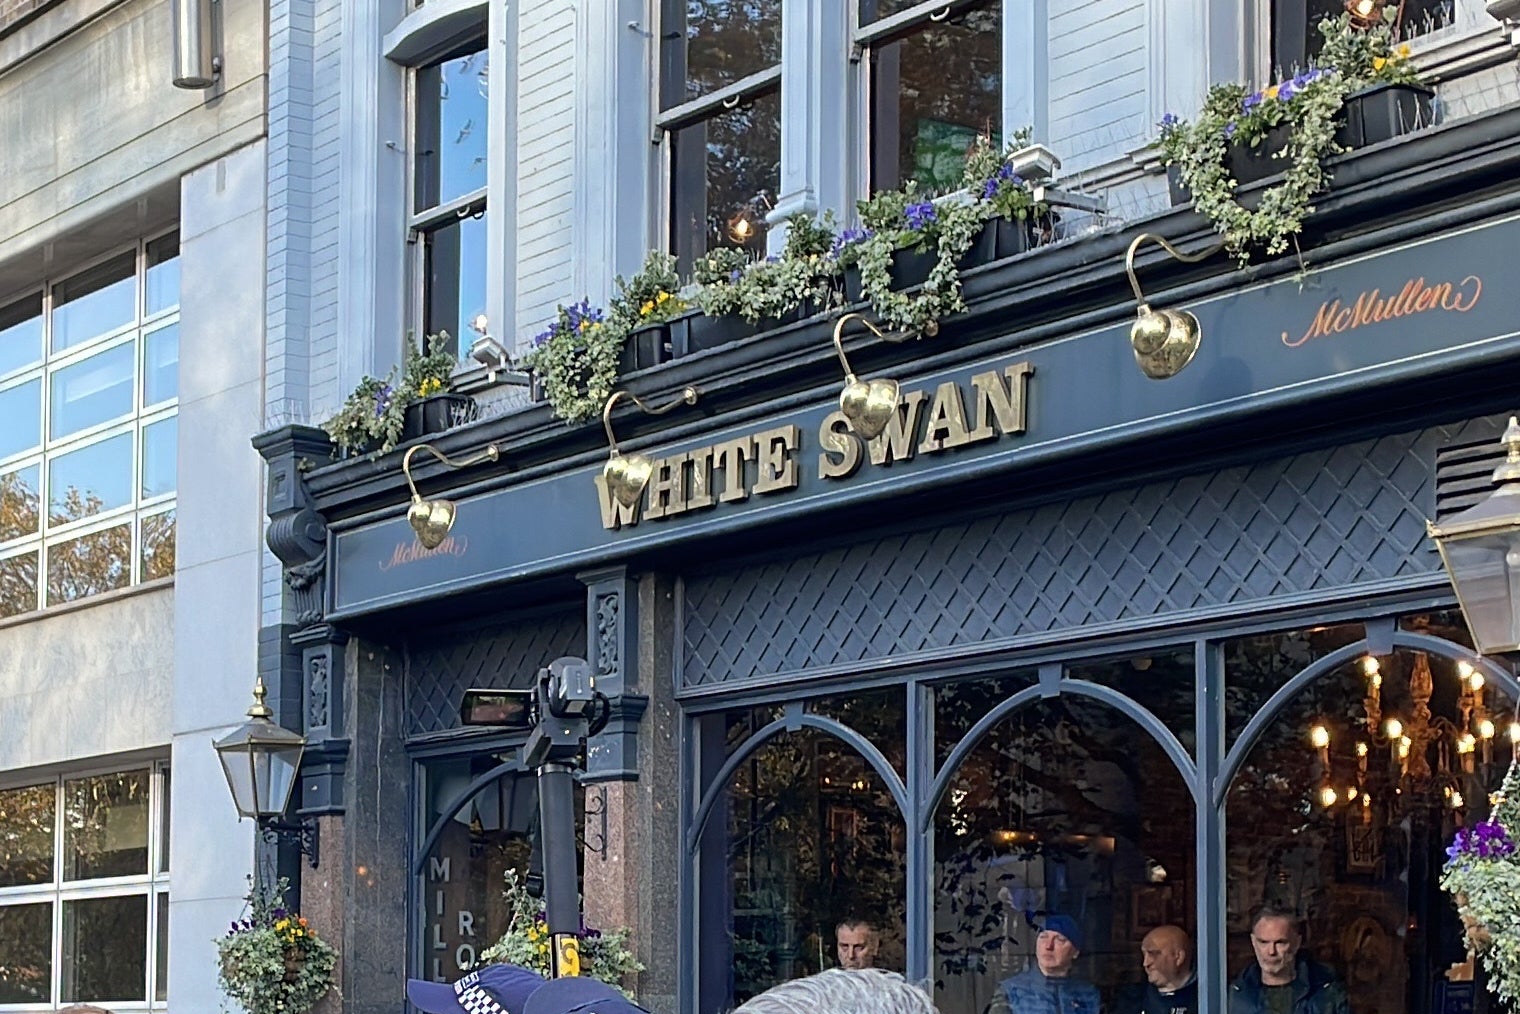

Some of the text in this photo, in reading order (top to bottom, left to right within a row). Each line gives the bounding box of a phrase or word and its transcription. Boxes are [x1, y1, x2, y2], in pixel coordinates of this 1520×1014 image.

[1282, 275, 1482, 346] McMullen
[594, 361, 1034, 529] WHITE SWAN
